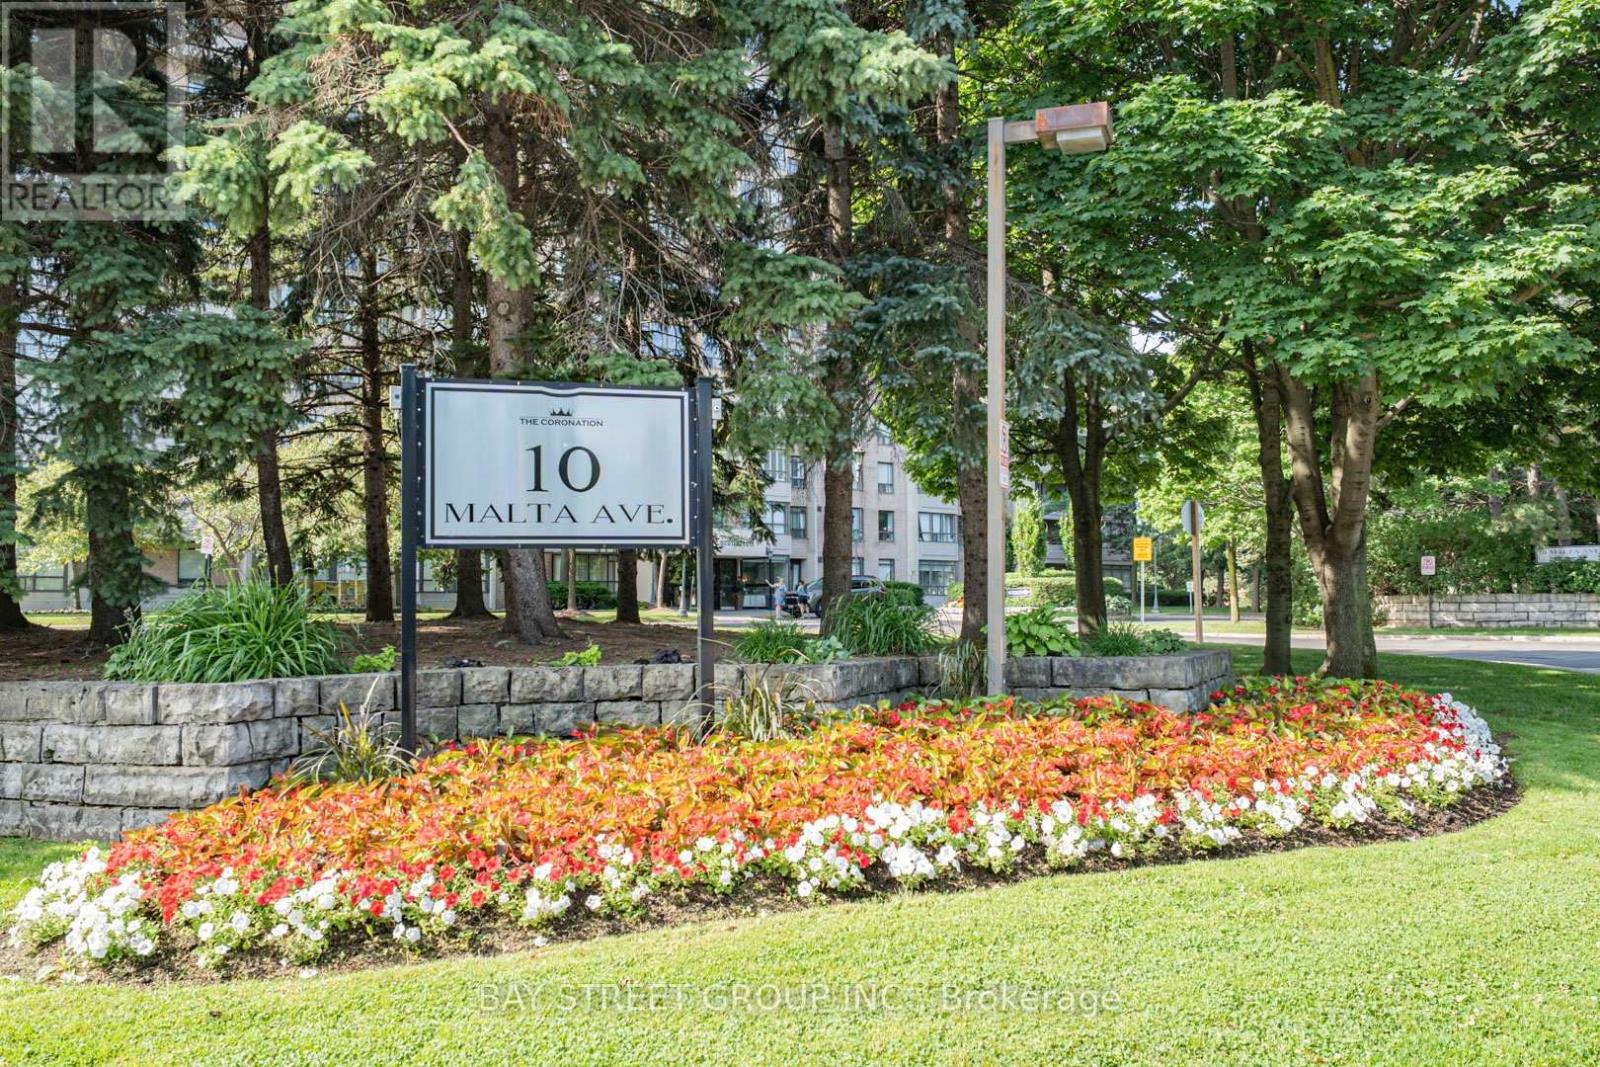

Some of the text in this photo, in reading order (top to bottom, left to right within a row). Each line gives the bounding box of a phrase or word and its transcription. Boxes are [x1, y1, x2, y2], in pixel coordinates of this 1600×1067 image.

[520, 418, 604, 427] THE CORONATION
[525, 445, 601, 493] 10
[444, 503, 673, 525] MALTA AVE.
